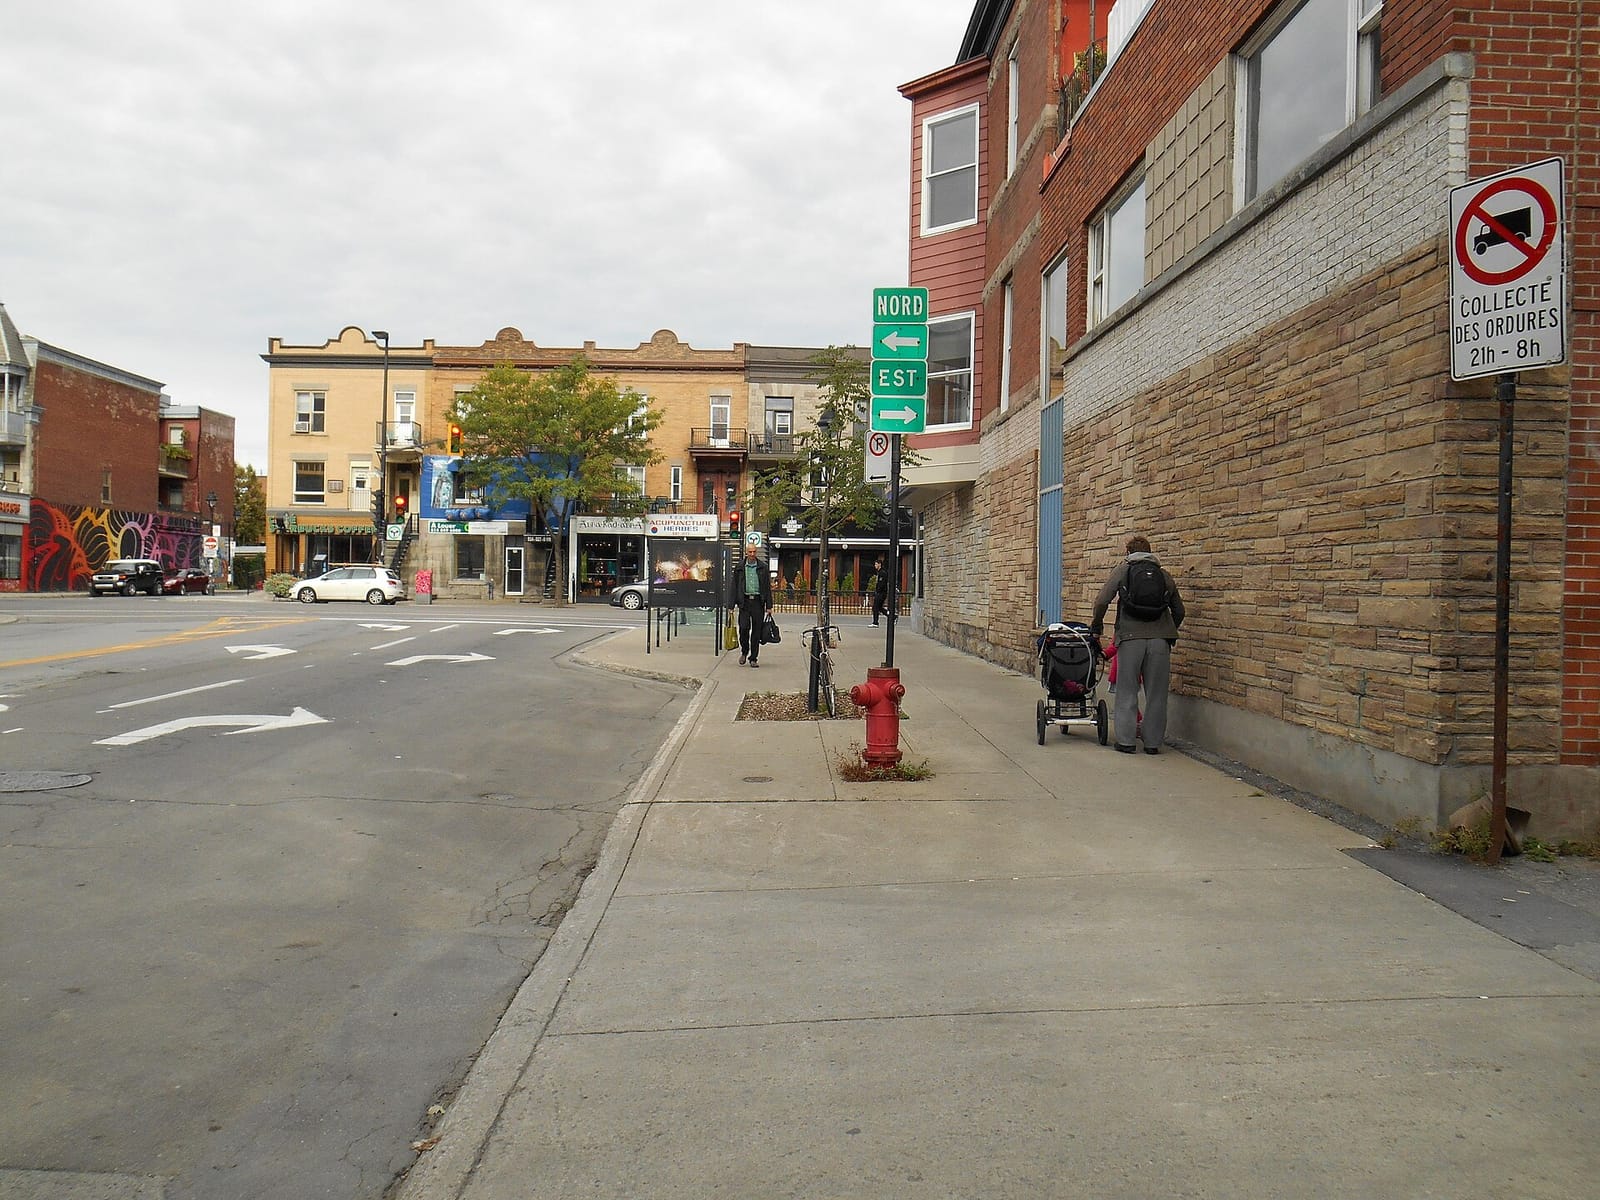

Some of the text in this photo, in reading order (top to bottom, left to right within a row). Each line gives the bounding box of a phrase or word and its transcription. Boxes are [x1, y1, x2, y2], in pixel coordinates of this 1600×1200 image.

[877, 295, 923, 316] NORD
[1460, 282, 1552, 318] COLLECTE
[1455, 307, 1559, 345] DES ORDURES
[1470, 345, 1496, 367] 21h
[1516, 338, 1541, 359] 8h
[878, 369, 917, 388] EST
